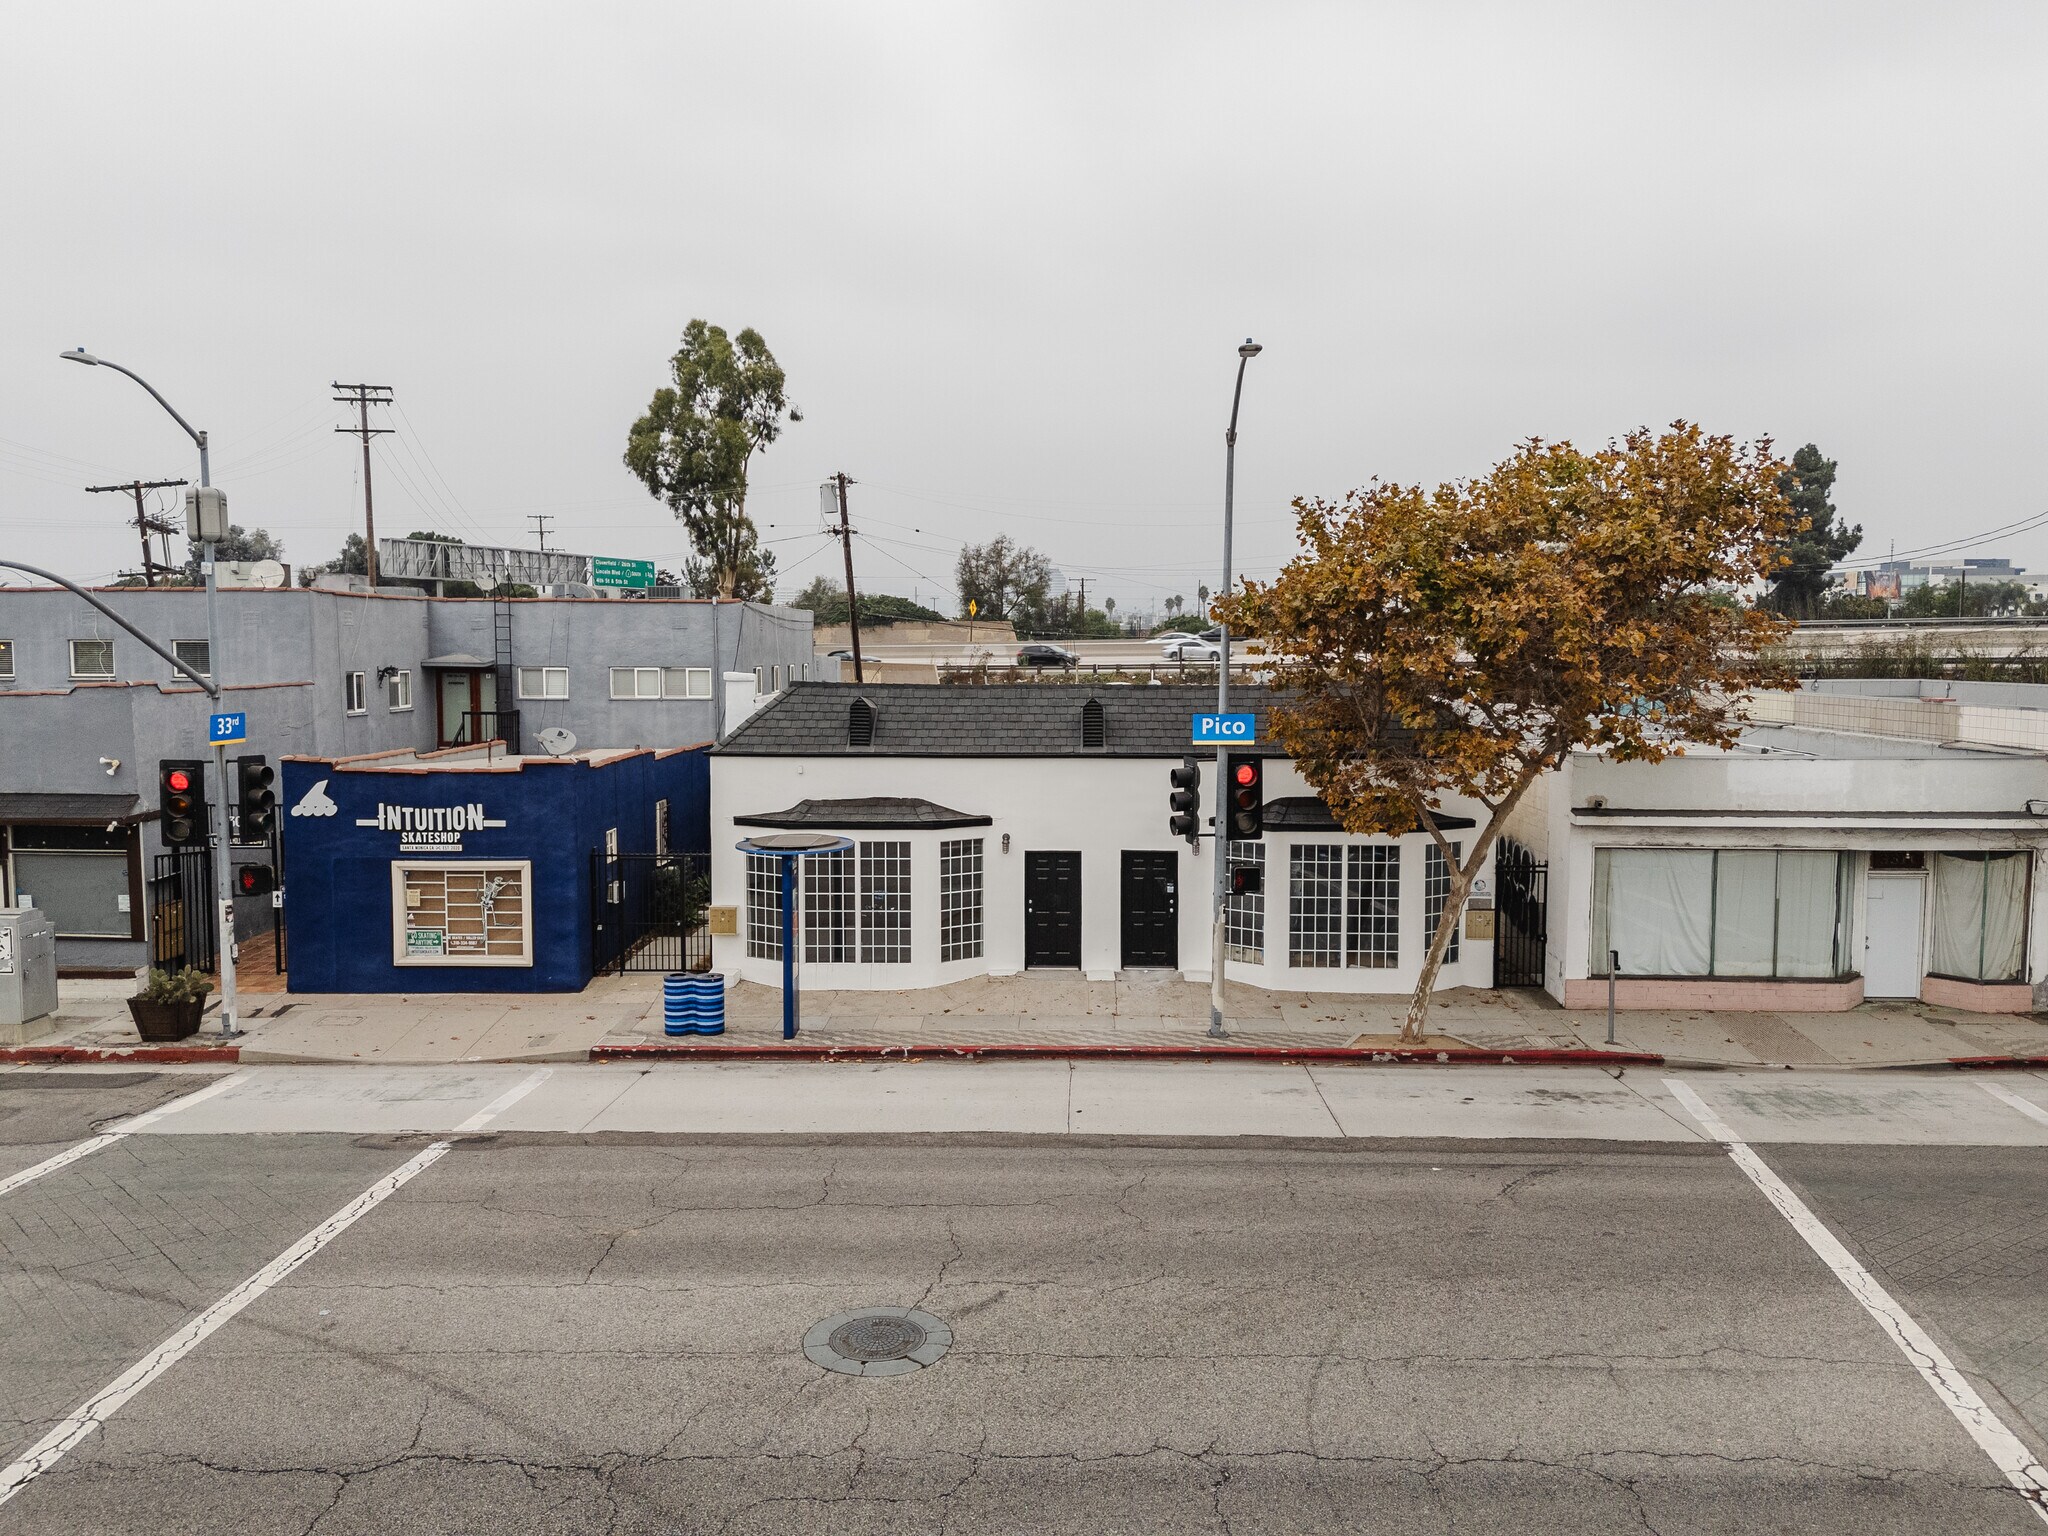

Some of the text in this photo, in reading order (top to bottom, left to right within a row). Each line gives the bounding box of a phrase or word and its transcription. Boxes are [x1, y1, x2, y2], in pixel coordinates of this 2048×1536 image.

[217, 716, 240, 735] 33rd
[1202, 717, 1246, 735] Pico
[377, 802, 484, 831] INTUITION
[401, 832, 461, 843] SKATESHOP
